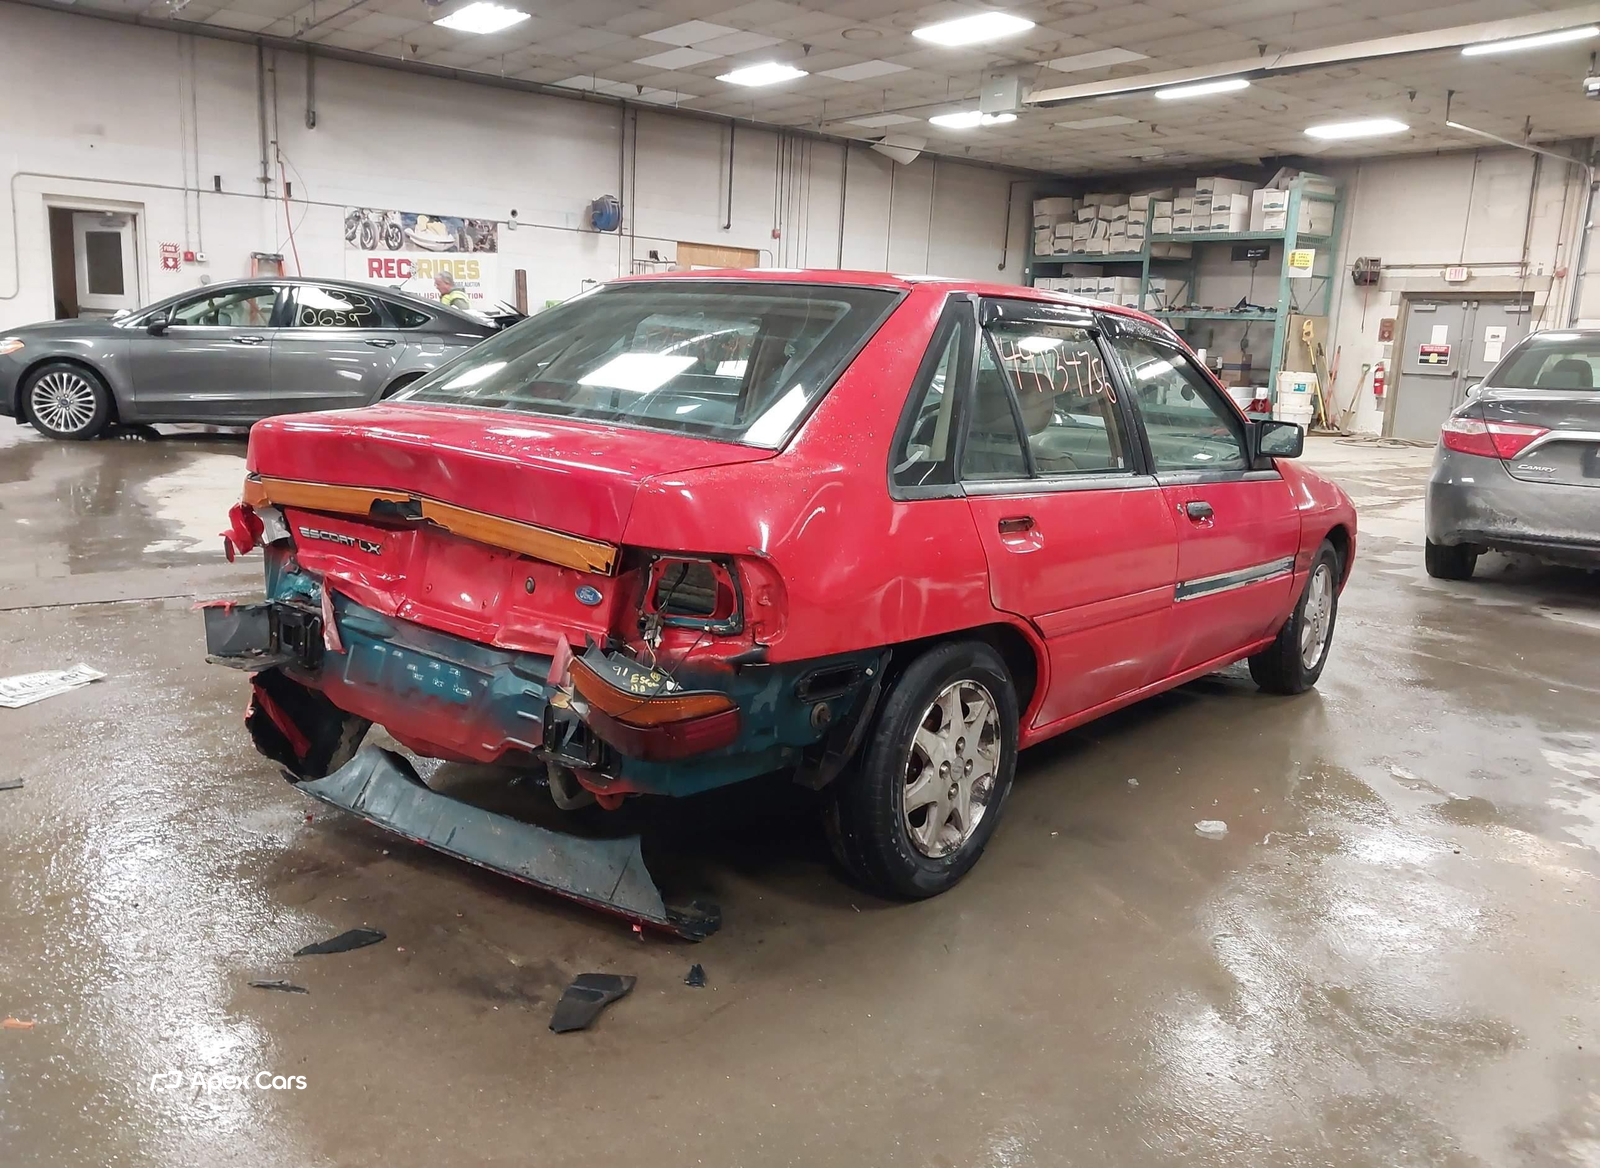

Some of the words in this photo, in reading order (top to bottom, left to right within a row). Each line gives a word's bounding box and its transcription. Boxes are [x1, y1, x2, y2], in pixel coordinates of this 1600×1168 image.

[368, 258, 412, 278] REC
[417, 259, 480, 280] RIDES
[1449, 269, 1465, 279] EXIT
[1518, 464, 1557, 472] CAMRY
[298, 526, 356, 547] ESCORT
[358, 539, 382, 556] LX
[613, 666, 628, 676] 91
